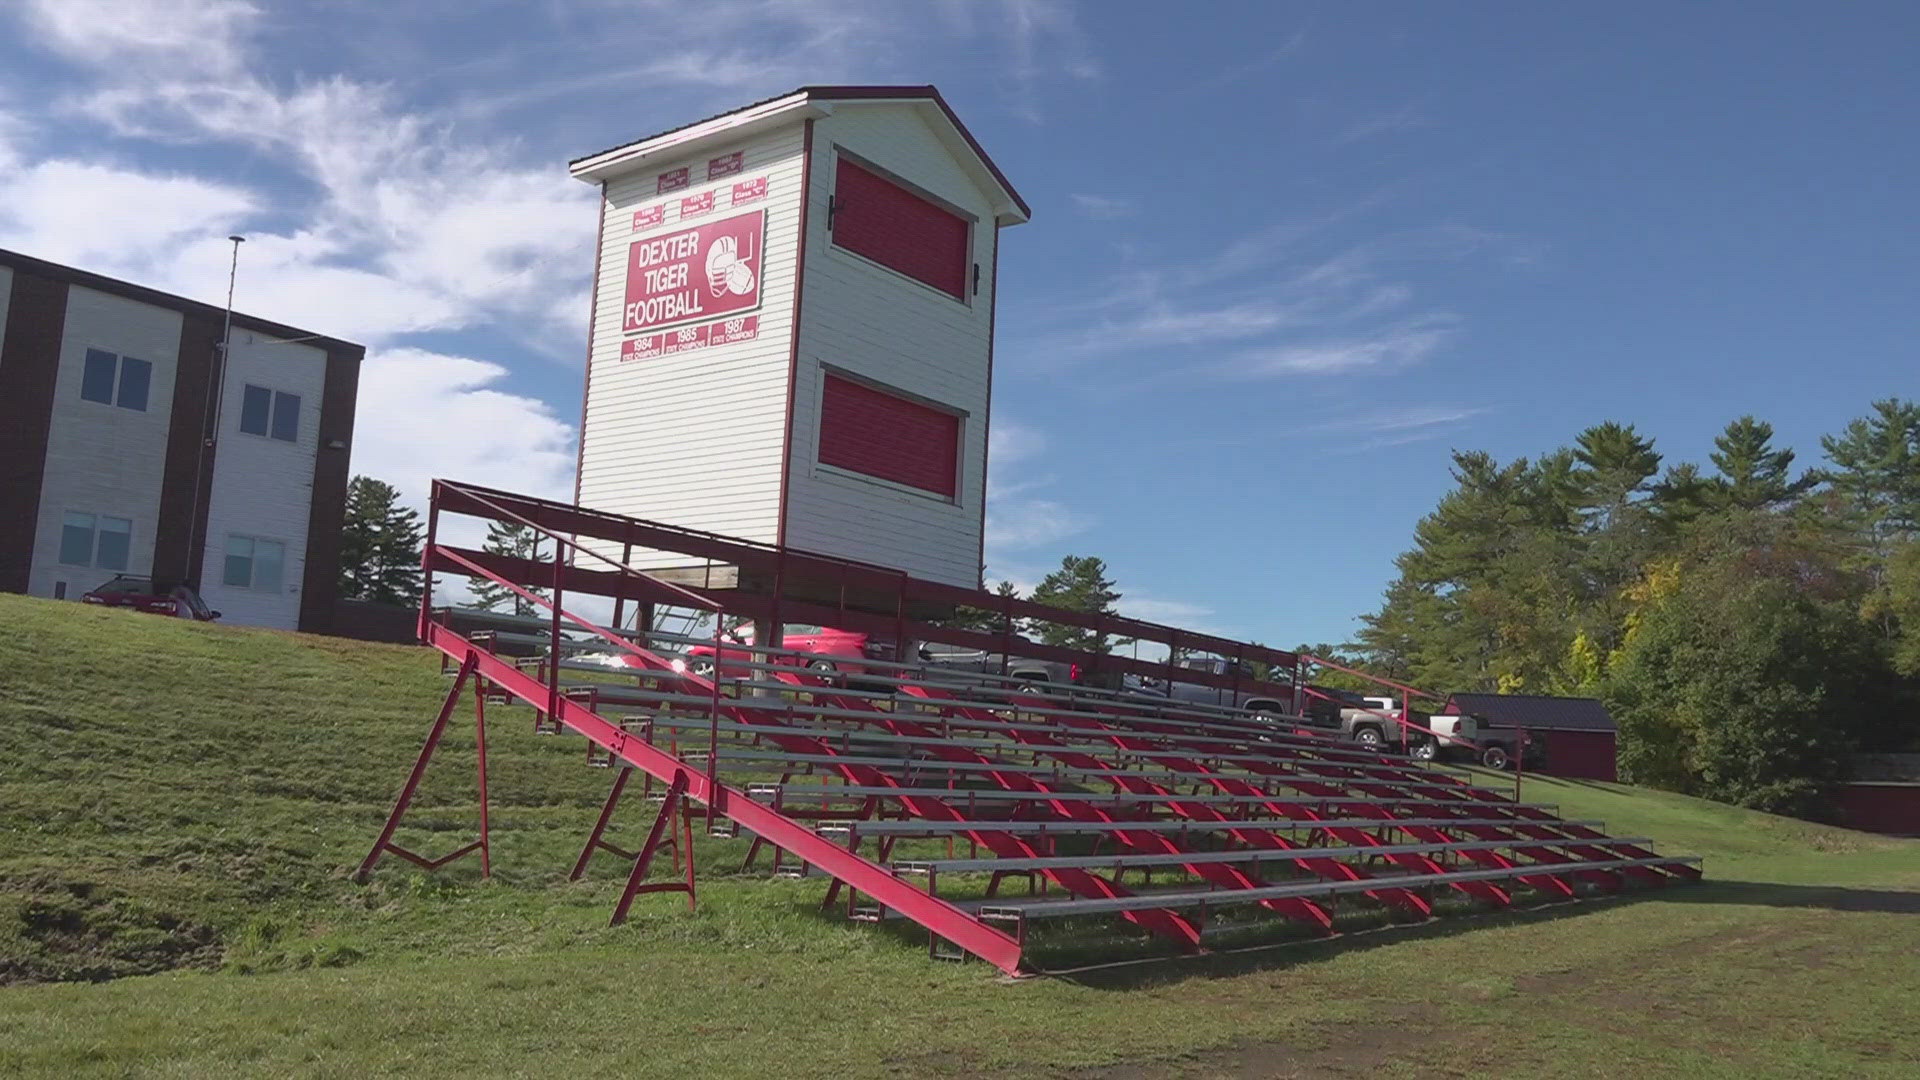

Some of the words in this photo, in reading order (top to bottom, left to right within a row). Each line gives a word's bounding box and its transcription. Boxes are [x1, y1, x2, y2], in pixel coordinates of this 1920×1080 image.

[734, 190, 752, 199] Class
[683, 204, 699, 213] Class
[638, 231, 700, 268] DEXTER
[644, 262, 689, 295] TIGER
[625, 288, 703, 327] FOOTBALL
[724, 318, 745, 332] 1987
[677, 329, 697, 343] 1985
[725, 329, 754, 342] CHAMPIONS
[633, 338, 653, 349] 1984
[678, 340, 706, 352] CHAMPIONS
[634, 349, 660, 360] CHAMPIONS
